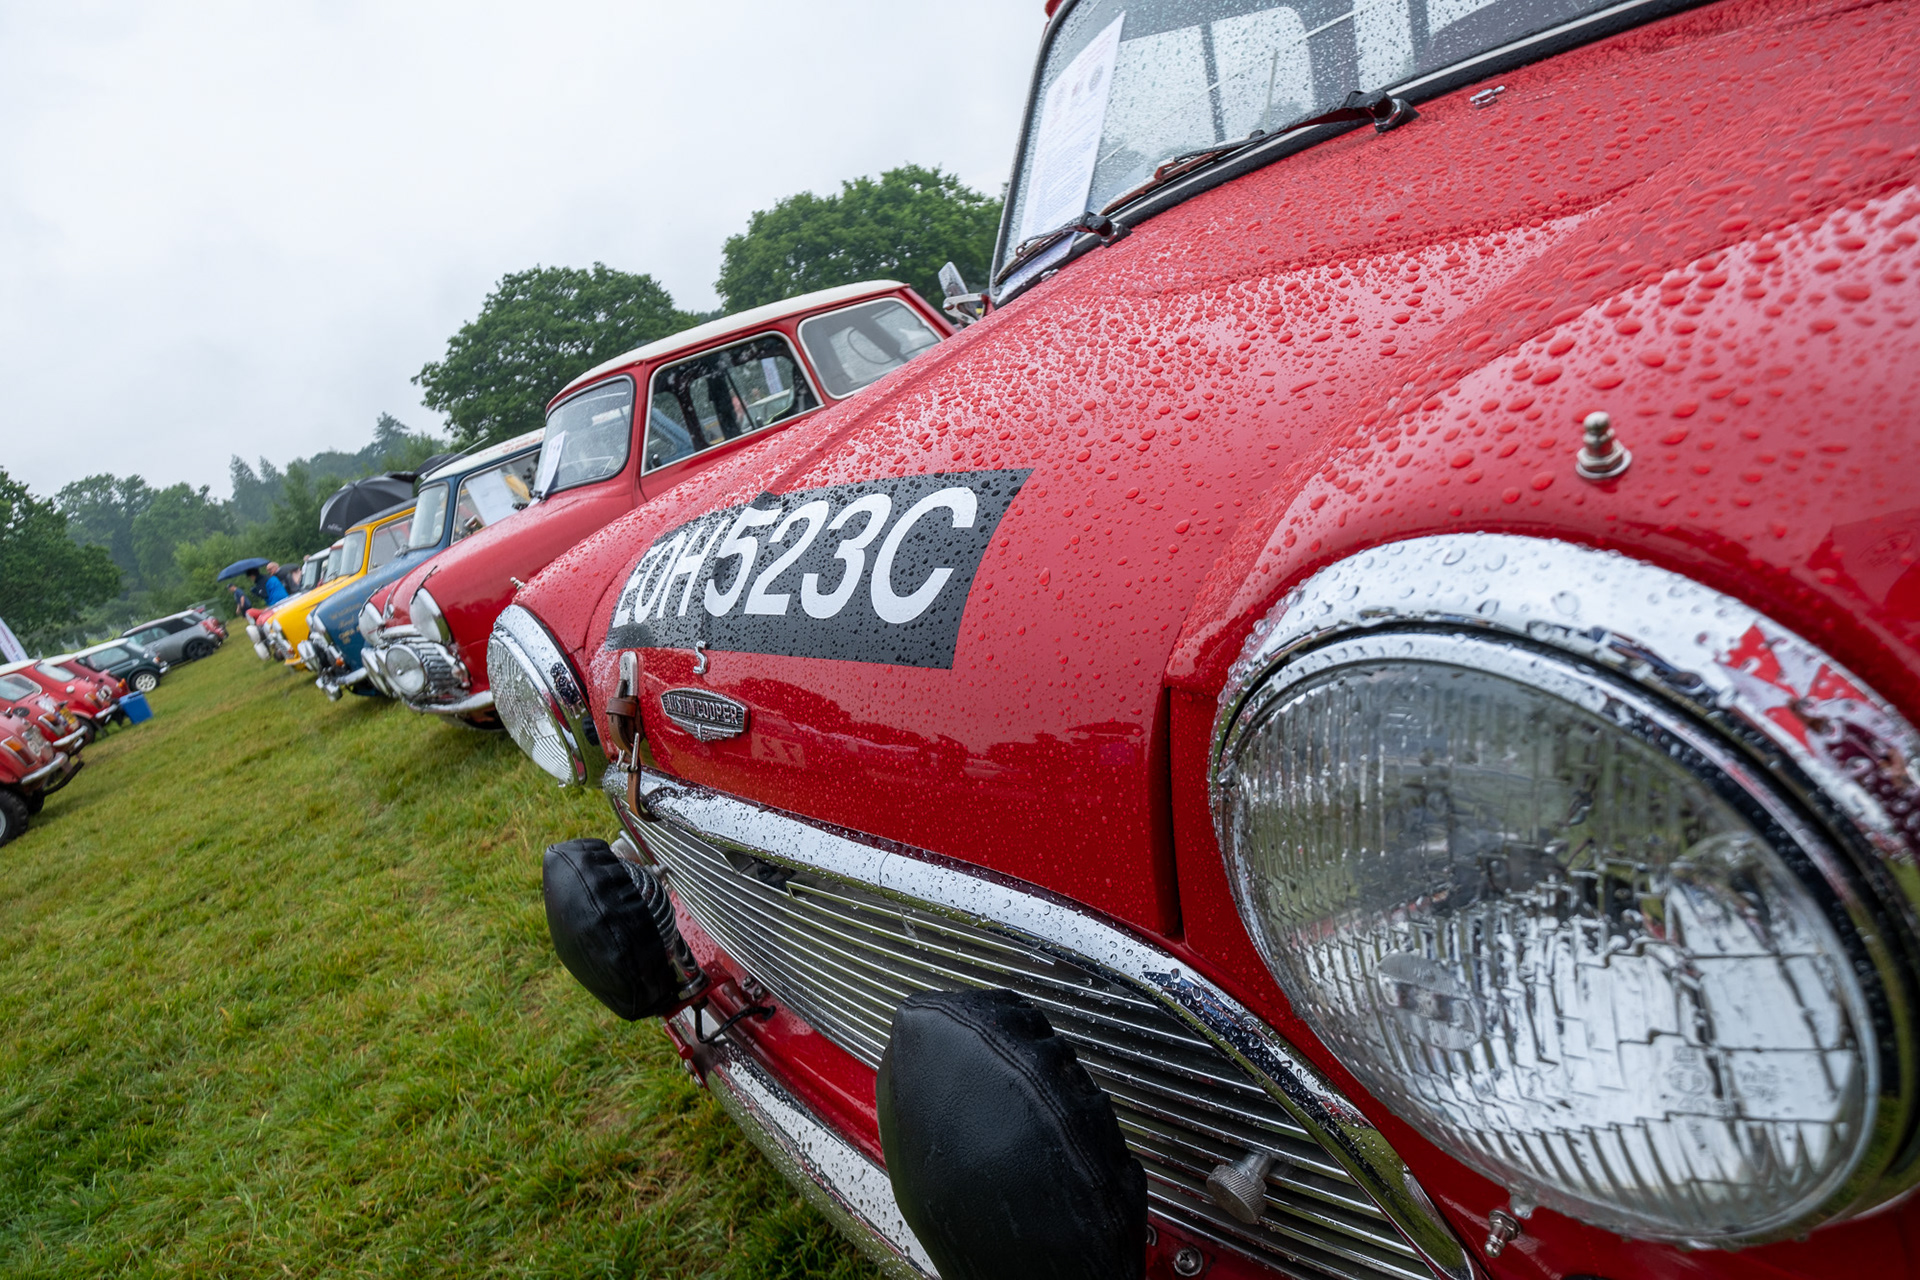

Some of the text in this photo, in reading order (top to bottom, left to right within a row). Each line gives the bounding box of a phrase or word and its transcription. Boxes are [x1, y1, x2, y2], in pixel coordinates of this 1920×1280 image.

[692, 640, 707, 674] S
[666, 694, 739, 725] AUSTIN COOPER
